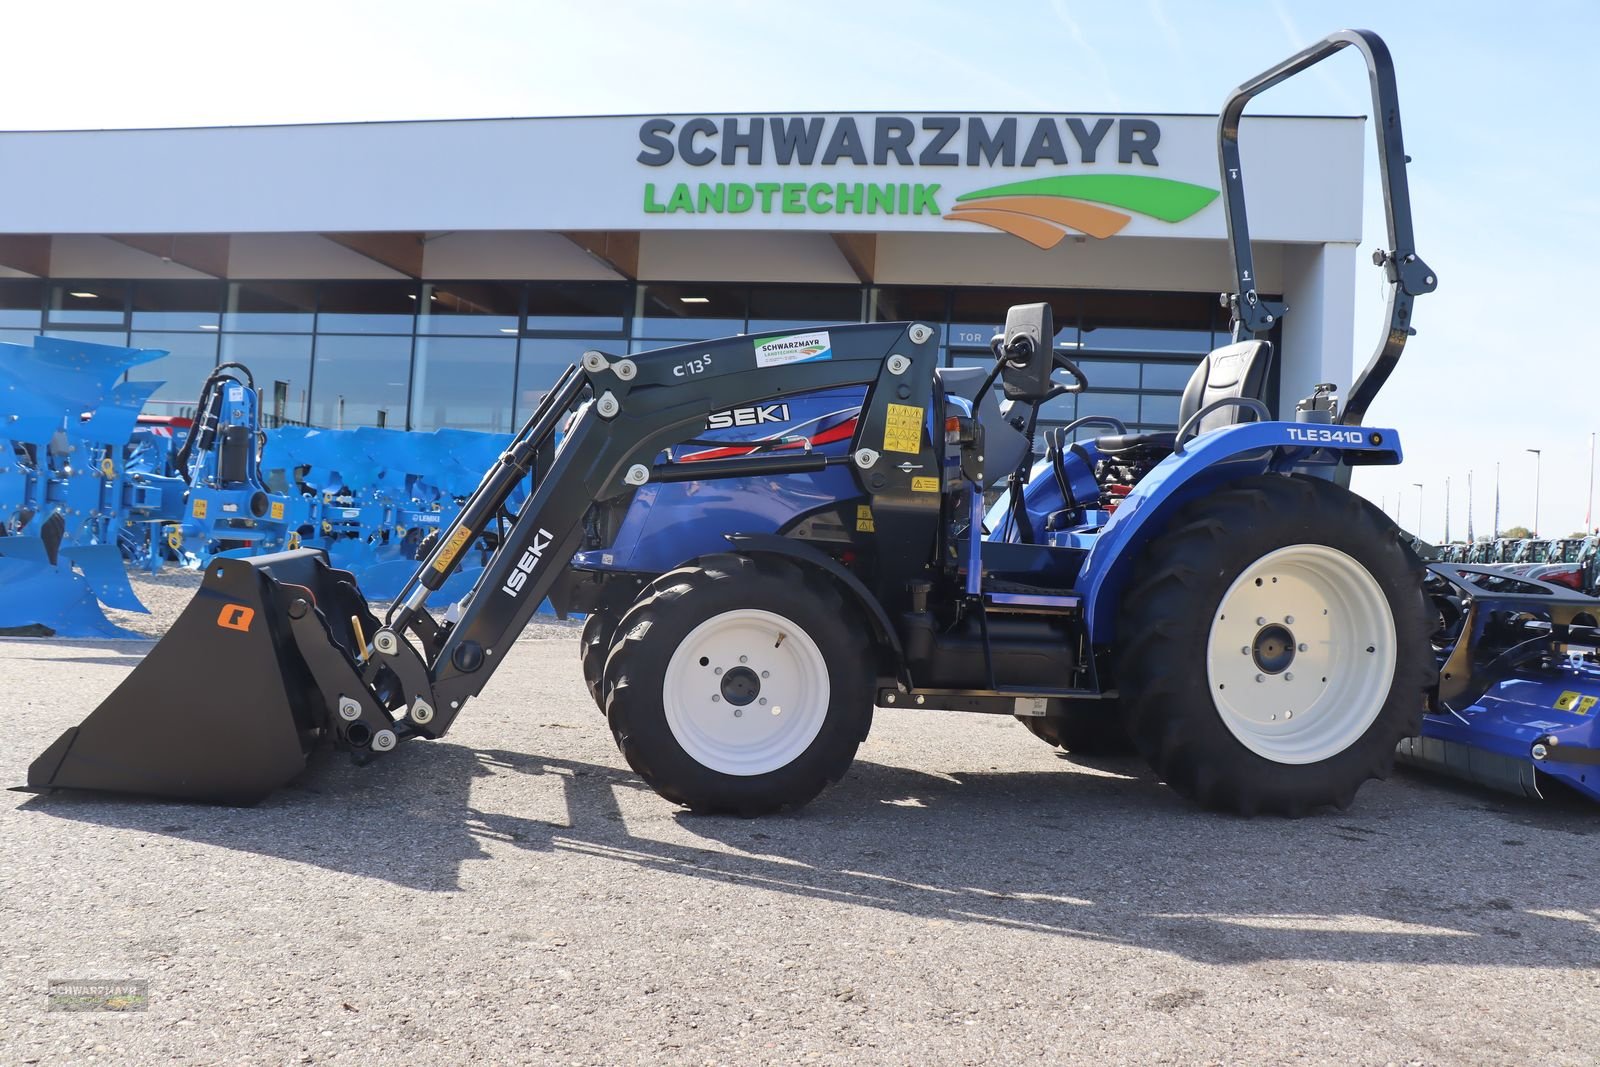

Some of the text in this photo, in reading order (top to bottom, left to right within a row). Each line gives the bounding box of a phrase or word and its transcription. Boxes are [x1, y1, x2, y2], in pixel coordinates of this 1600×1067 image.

[636, 117, 1161, 167] SCHWARZMAYR
[643, 182, 942, 215] LANDTECHNIK
[762, 339, 820, 352] SCHWARZMAYR
[960, 332, 982, 342] TOR
[704, 404, 790, 430] SEKI
[1286, 428, 1363, 443] TLE3410
[502, 528, 554, 598] ISEKI
